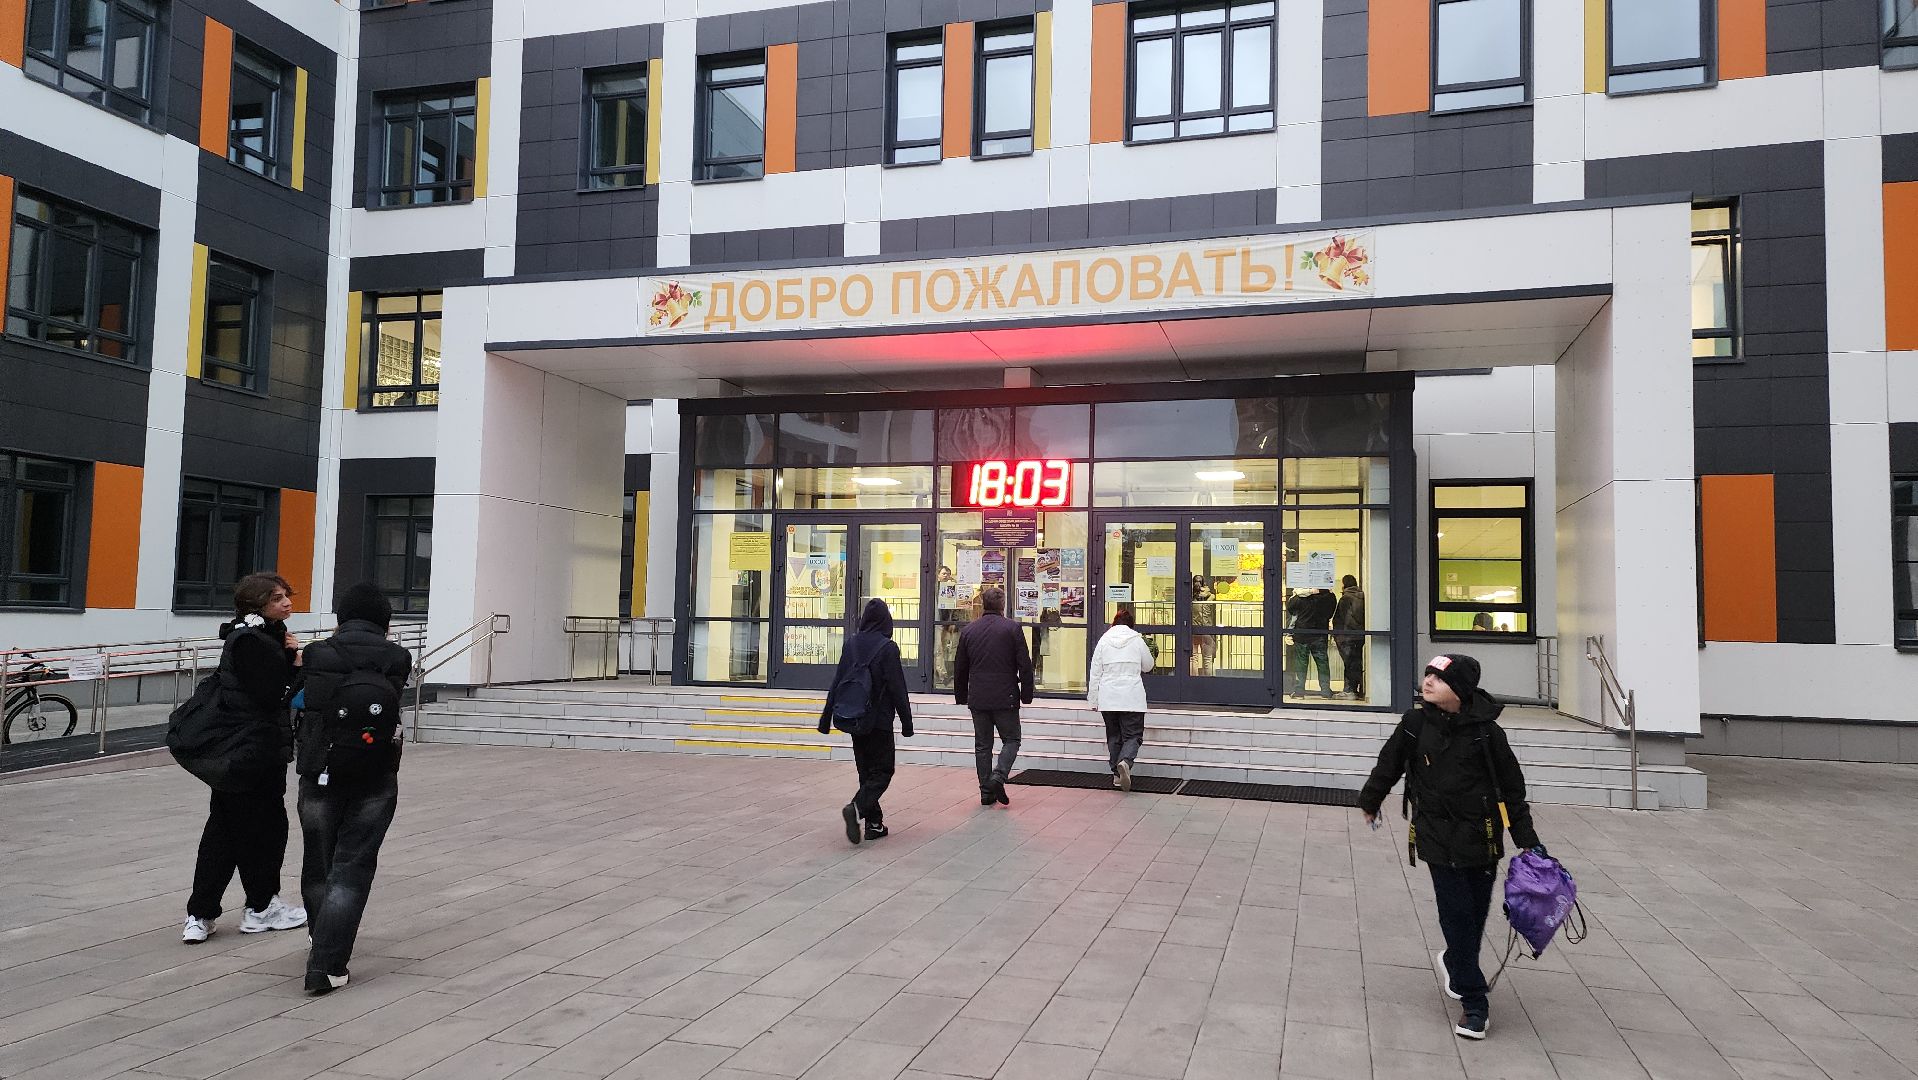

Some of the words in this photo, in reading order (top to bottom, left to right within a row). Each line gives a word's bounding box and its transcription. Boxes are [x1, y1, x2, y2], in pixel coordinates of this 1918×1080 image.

[703, 274, 874, 331] ДОБРО
[891, 244, 1295, 316] ПОЖАЛОВАТЬ!
[969, 460, 1070, 507] 18:03
